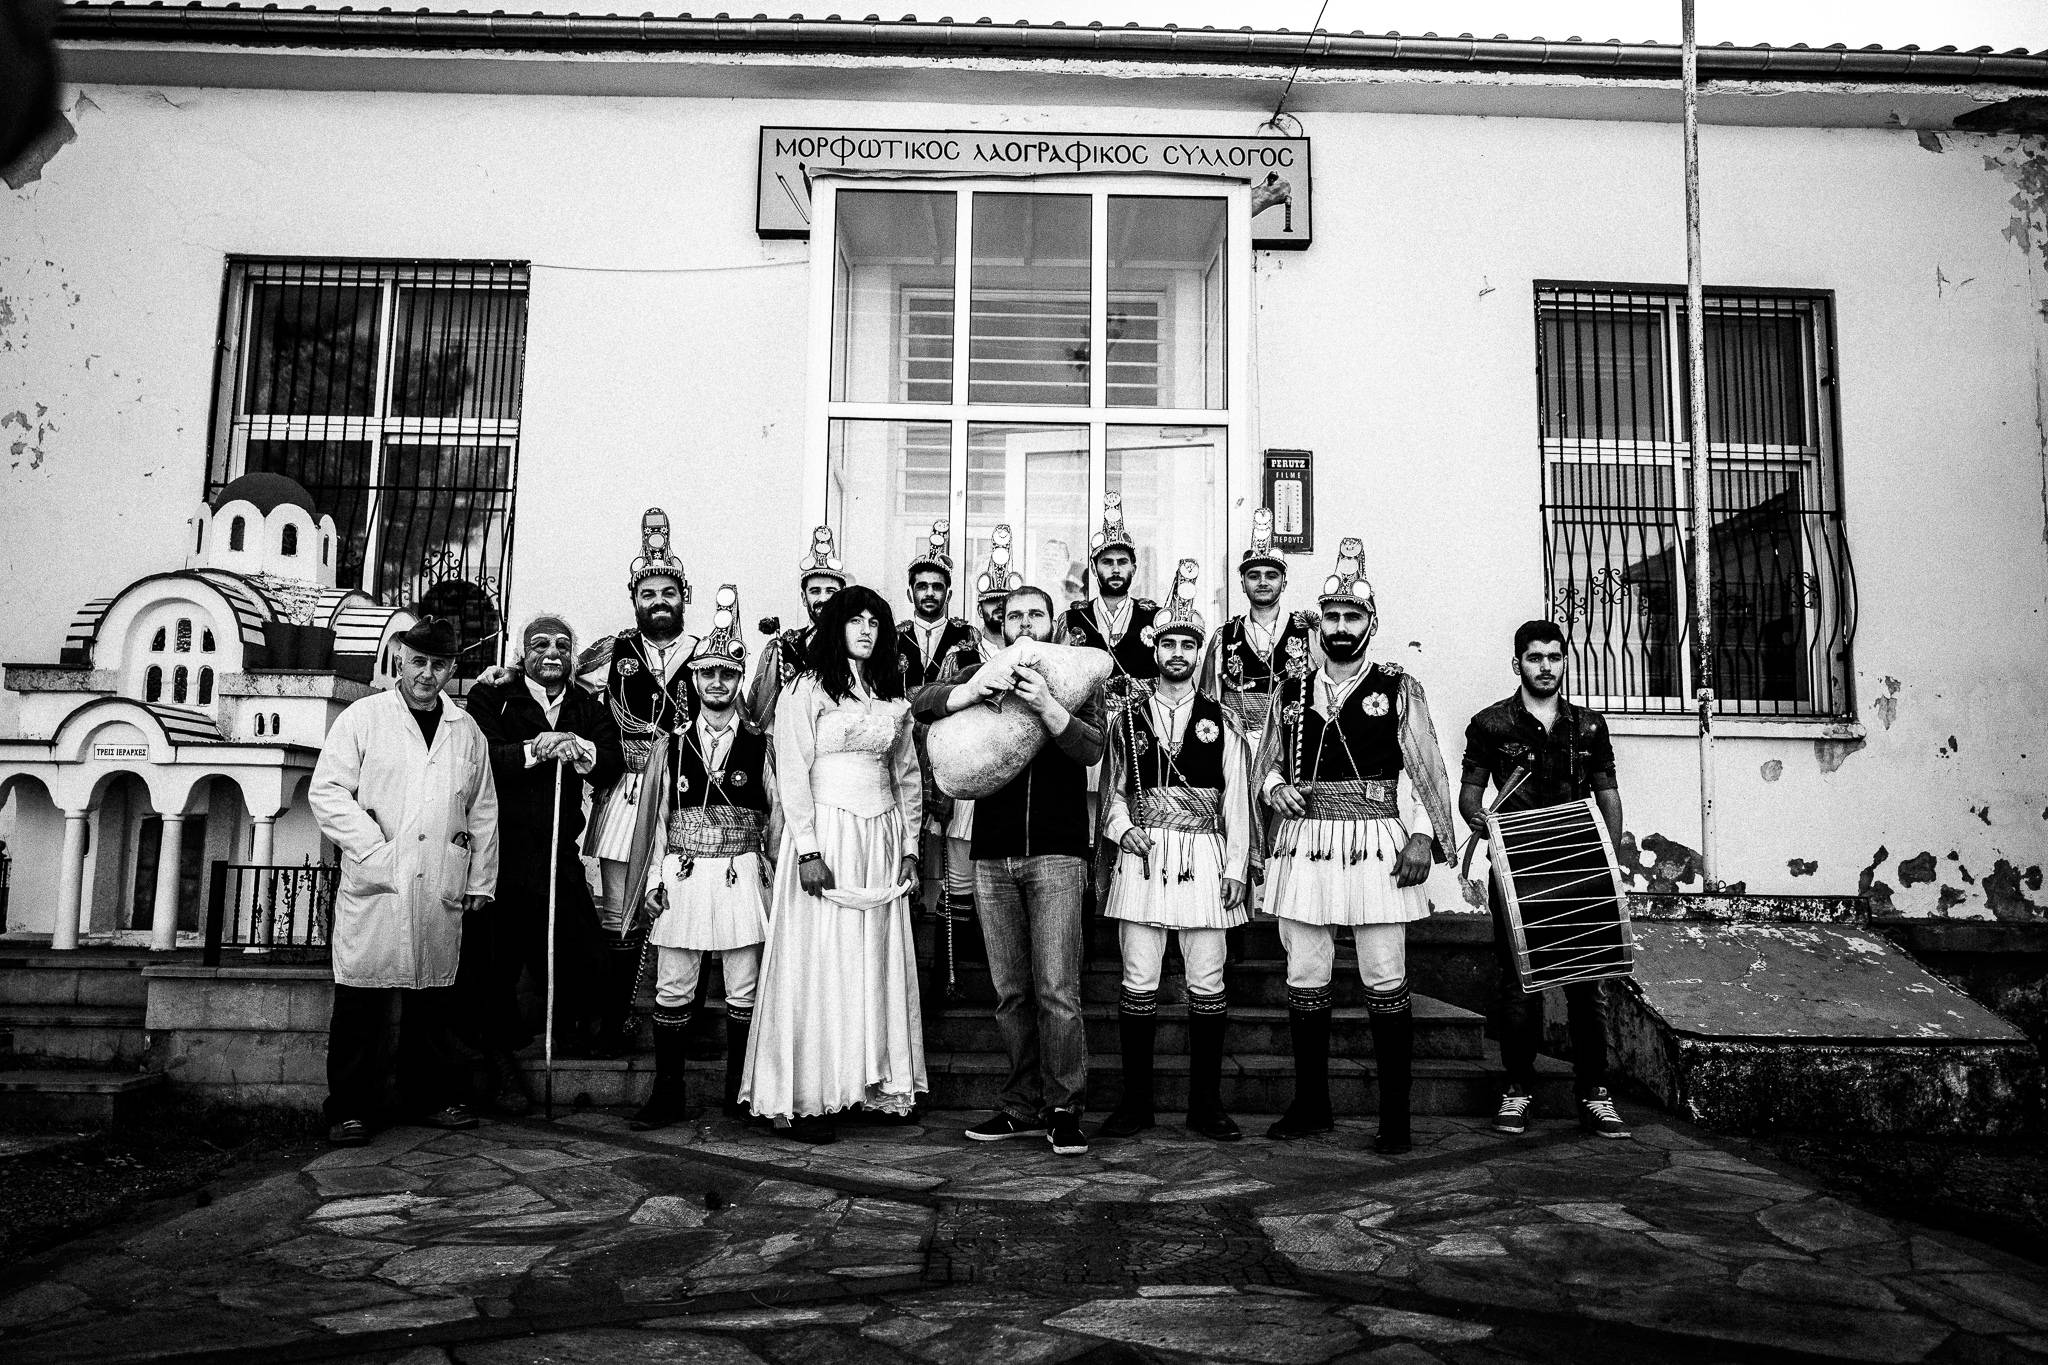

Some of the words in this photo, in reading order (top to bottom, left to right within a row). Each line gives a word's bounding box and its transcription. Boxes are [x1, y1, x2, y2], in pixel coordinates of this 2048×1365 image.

[1271, 459, 1306, 468] PERUTZ
[1275, 471, 1301, 479] FILME
[96, 748, 115, 756] ΤΡΕΙΣ
[116, 748, 147, 756] ΙΕΡΑΡΧΕΣ
